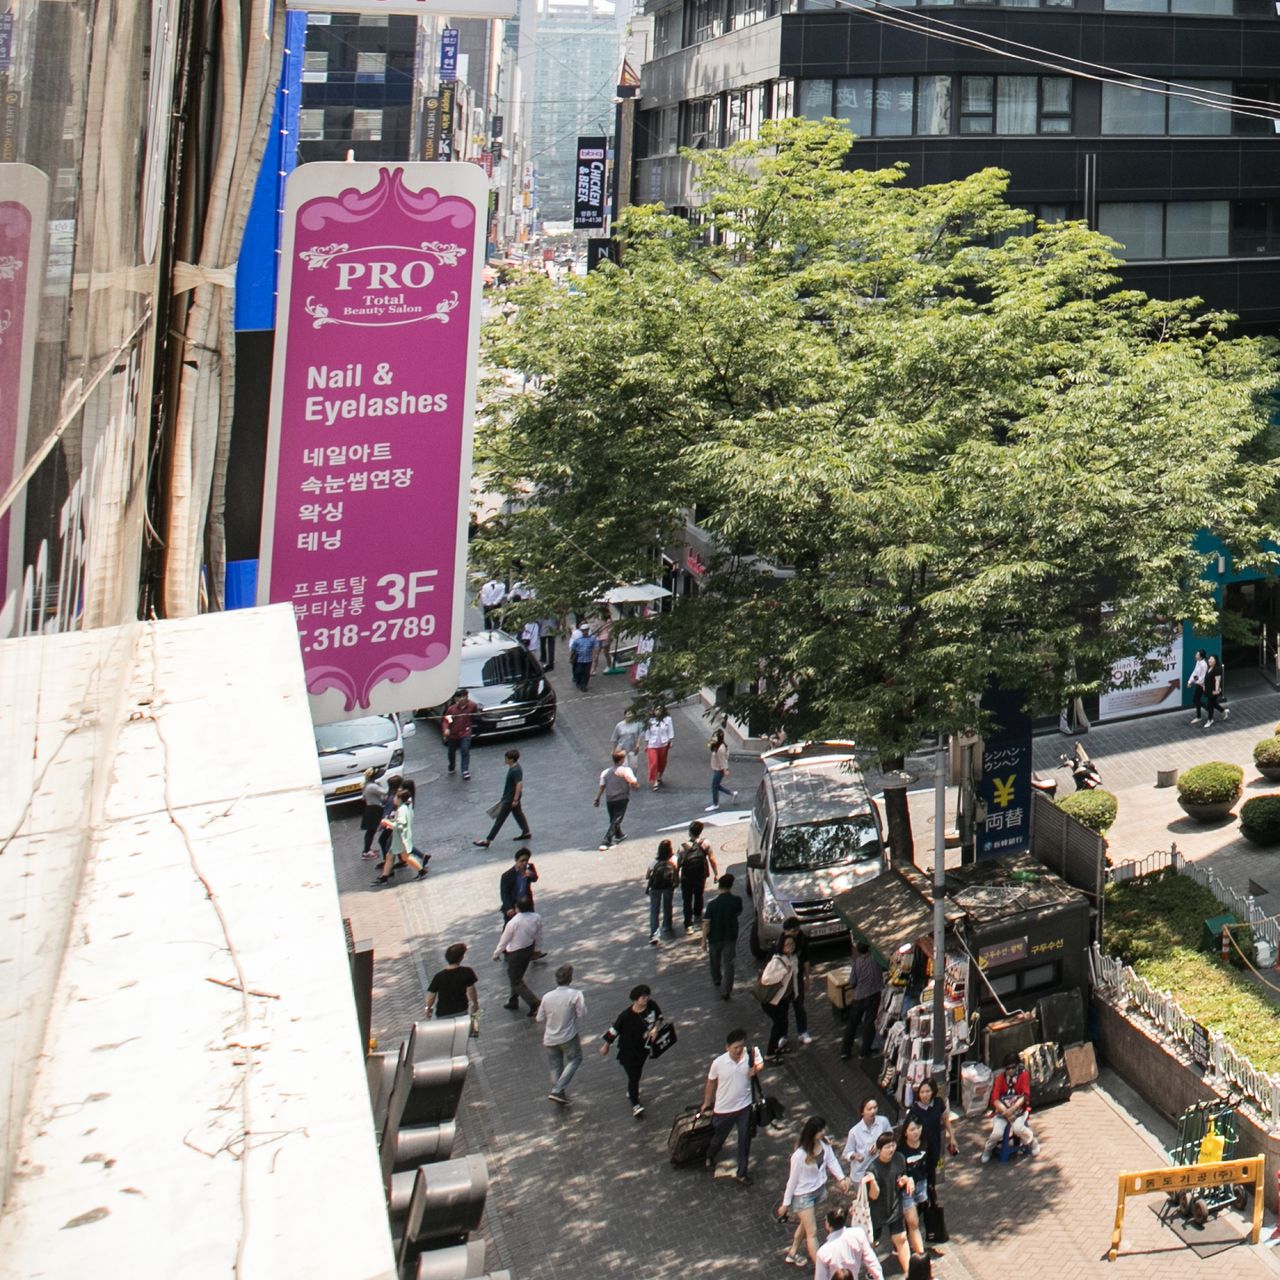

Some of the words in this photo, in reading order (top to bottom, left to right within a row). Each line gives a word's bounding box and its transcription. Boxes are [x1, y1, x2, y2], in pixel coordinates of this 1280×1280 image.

[427, 123, 435, 139] STAY
[425, 139, 433, 160] HOTEL
[589, 161, 604, 207] CHICKEN
[334, 260, 435, 291] PRO
[344, 306, 385, 316] Beauty
[388, 305, 422, 314] Salon
[363, 294, 404, 305] Total
[307, 364, 362, 389] Nail
[373, 362, 394, 386] &
[305, 390, 448, 426] Eyelashes
[303, 442, 392, 467] 네일아트
[300, 468, 414, 495] 속눈썹연장
[298, 501, 344, 523] 왁싱
[297, 530, 342, 551] 테닝
[292, 576, 368, 599] 프로토탈
[375, 570, 438, 612] 3F
[294, 597, 366, 620] 뷰티살롱
[299, 614, 436, 652] .318-2789
[986, 807, 1024, 833] 両替
